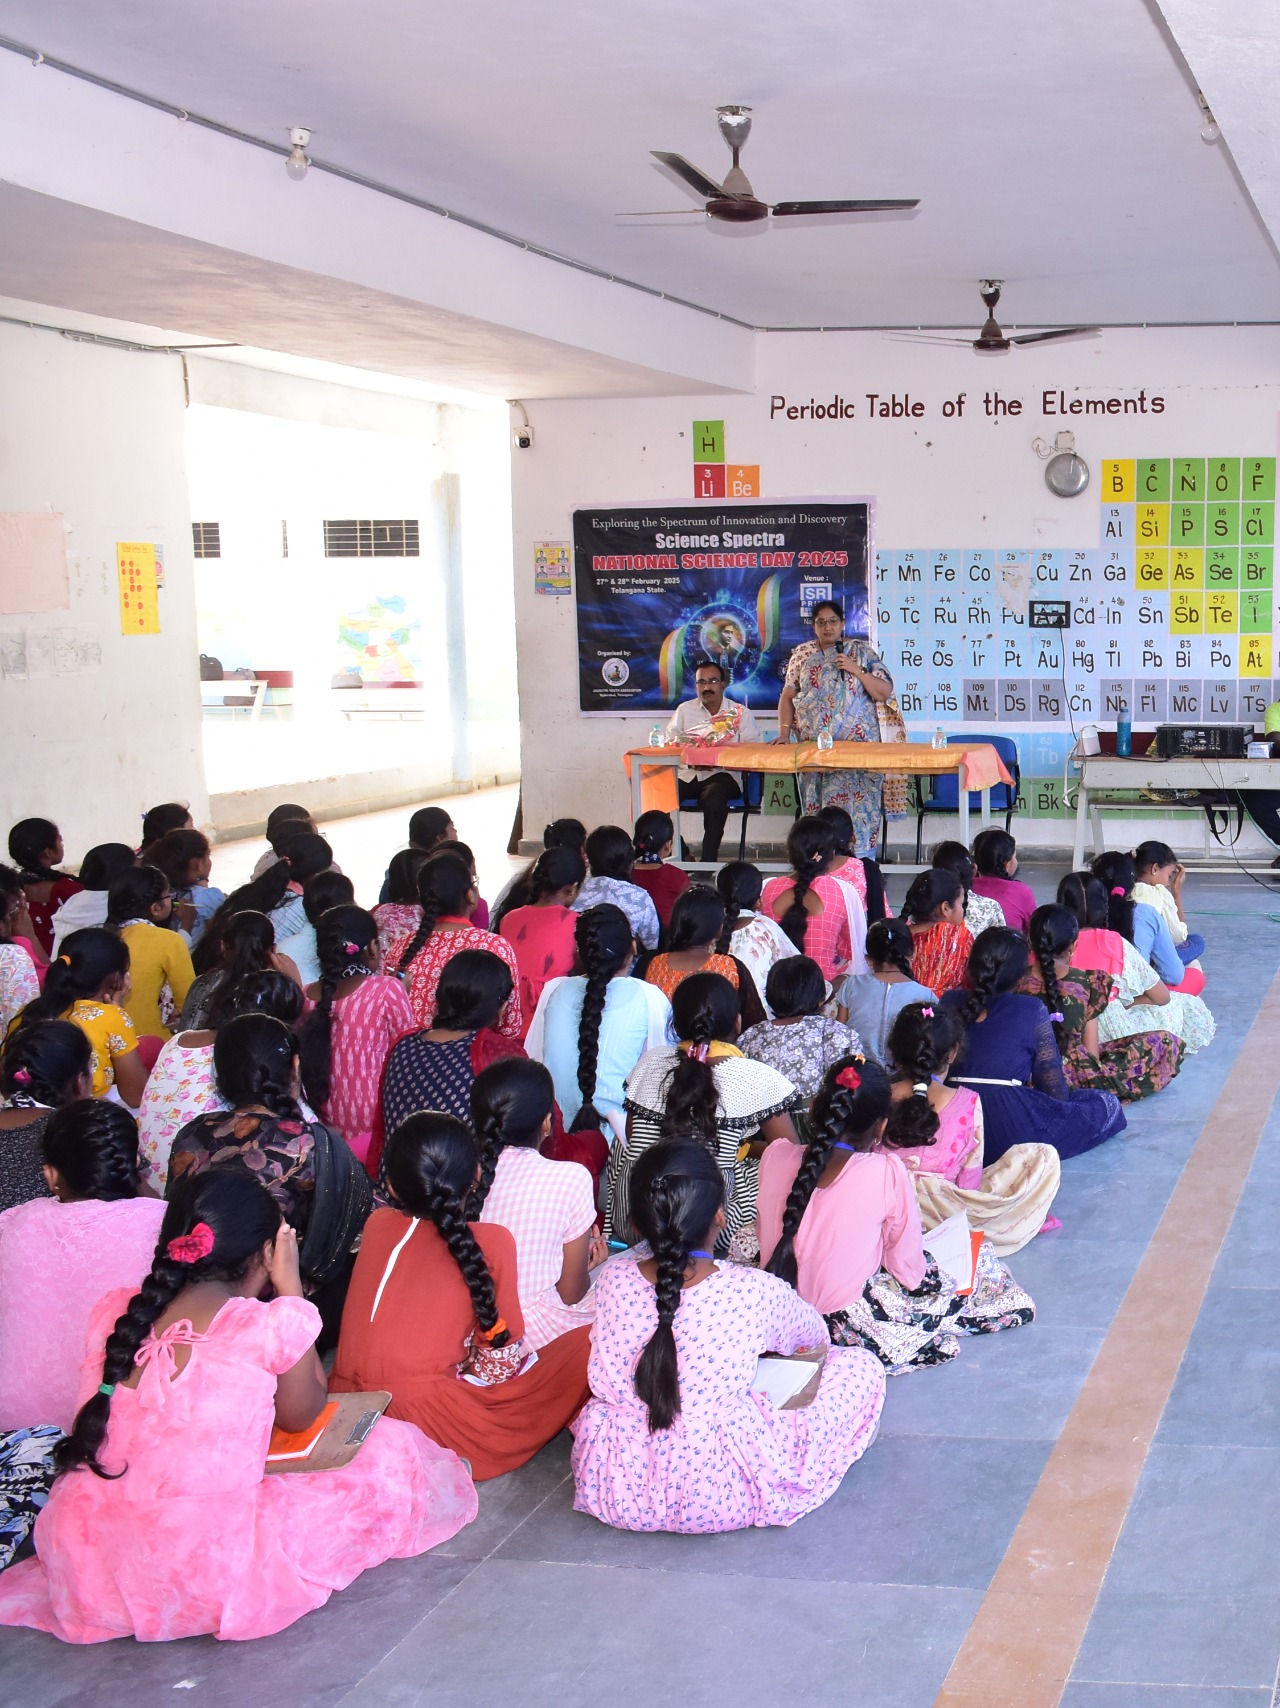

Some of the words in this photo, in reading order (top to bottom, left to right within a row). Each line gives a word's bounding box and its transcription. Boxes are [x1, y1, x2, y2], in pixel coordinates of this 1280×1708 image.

[770, 395, 855, 420] Periodic
[866, 394, 925, 418] Table
[942, 392, 966, 417] of
[983, 392, 1022, 416] the
[1042, 390, 1165, 414] Elements
[702, 437, 715, 452] H
[704, 470, 711, 478] 3
[702, 481, 714, 497] Li
[733, 481, 752, 497] Be
[1113, 476, 1123, 492] B
[1146, 476, 1158, 492] C
[1181, 476, 1196, 491] N
[1216, 475, 1228, 491] O
[1253, 475, 1264, 491] F
[592, 518, 640, 529] Exploring
[642, 518, 657, 527] the
[660, 516, 708, 528] Spectrum
[710, 516, 721, 526] of
[722, 515, 775, 525] Innovation
[778, 515, 796, 524] and
[799, 514, 847, 526] Discovery
[1106, 521, 1122, 537] Al
[1142, 521, 1159, 537] Si
[1182, 520, 1193, 536] P
[1214, 520, 1228, 536] S
[1246, 519, 1263, 536] Cl
[656, 533, 719, 548] Science
[723, 532, 785, 548] Spectra
[592, 555, 678, 571] NATIONAL
[681, 553, 757, 569] SCIENCE
[761, 552, 794, 568] DAY
[798, 551, 848, 567] 2025
[899, 565, 921, 582] Mn
[934, 566, 956, 581] Fe
[969, 565, 991, 581] Co
[1036, 564, 1058, 581] Cu
[1069, 564, 1092, 581] Zn
[1104, 565, 1126, 581] Ga
[1140, 564, 1163, 581] Ge
[1174, 564, 1194, 580] As
[1209, 564, 1233, 580] Se
[1247, 564, 1266, 580] Br
[631, 577, 661, 585] February
[806, 588, 826, 600] SR
[900, 607, 920, 624] Tc
[934, 607, 957, 624] Ru
[968, 607, 991, 624] Rh
[1074, 607, 1095, 624] Cd
[1106, 608, 1121, 624] In
[1139, 607, 1163, 624] Sn
[1174, 606, 1199, 623] Sb
[1209, 607, 1233, 623] Te
[902, 651, 923, 667] Re
[932, 651, 954, 667] Os
[973, 651, 985, 667] Ir
[1005, 651, 1022, 667] Pt
[1038, 651, 1059, 668] Au
[1073, 651, 1094, 673] Hg
[1105, 651, 1121, 668] Tl
[1142, 651, 1162, 668] Pb
[1176, 652, 1190, 668] Bi
[1211, 652, 1231, 668] Po
[1247, 651, 1263, 668] At
[902, 694, 922, 711] Bh
[934, 696, 958, 711] Hs
[967, 695, 989, 711] Mt
[1004, 695, 1026, 711] Ds
[1039, 695, 1060, 715] Rg
[1070, 696, 1092, 711] Cn
[1142, 696, 1156, 712] Fl
[1211, 697, 1229, 712] Lv
[1243, 696, 1266, 712] Ts
[774, 780, 784, 788] 89
[770, 791, 792, 808] Ac
[1039, 794, 1059, 810] Bk
